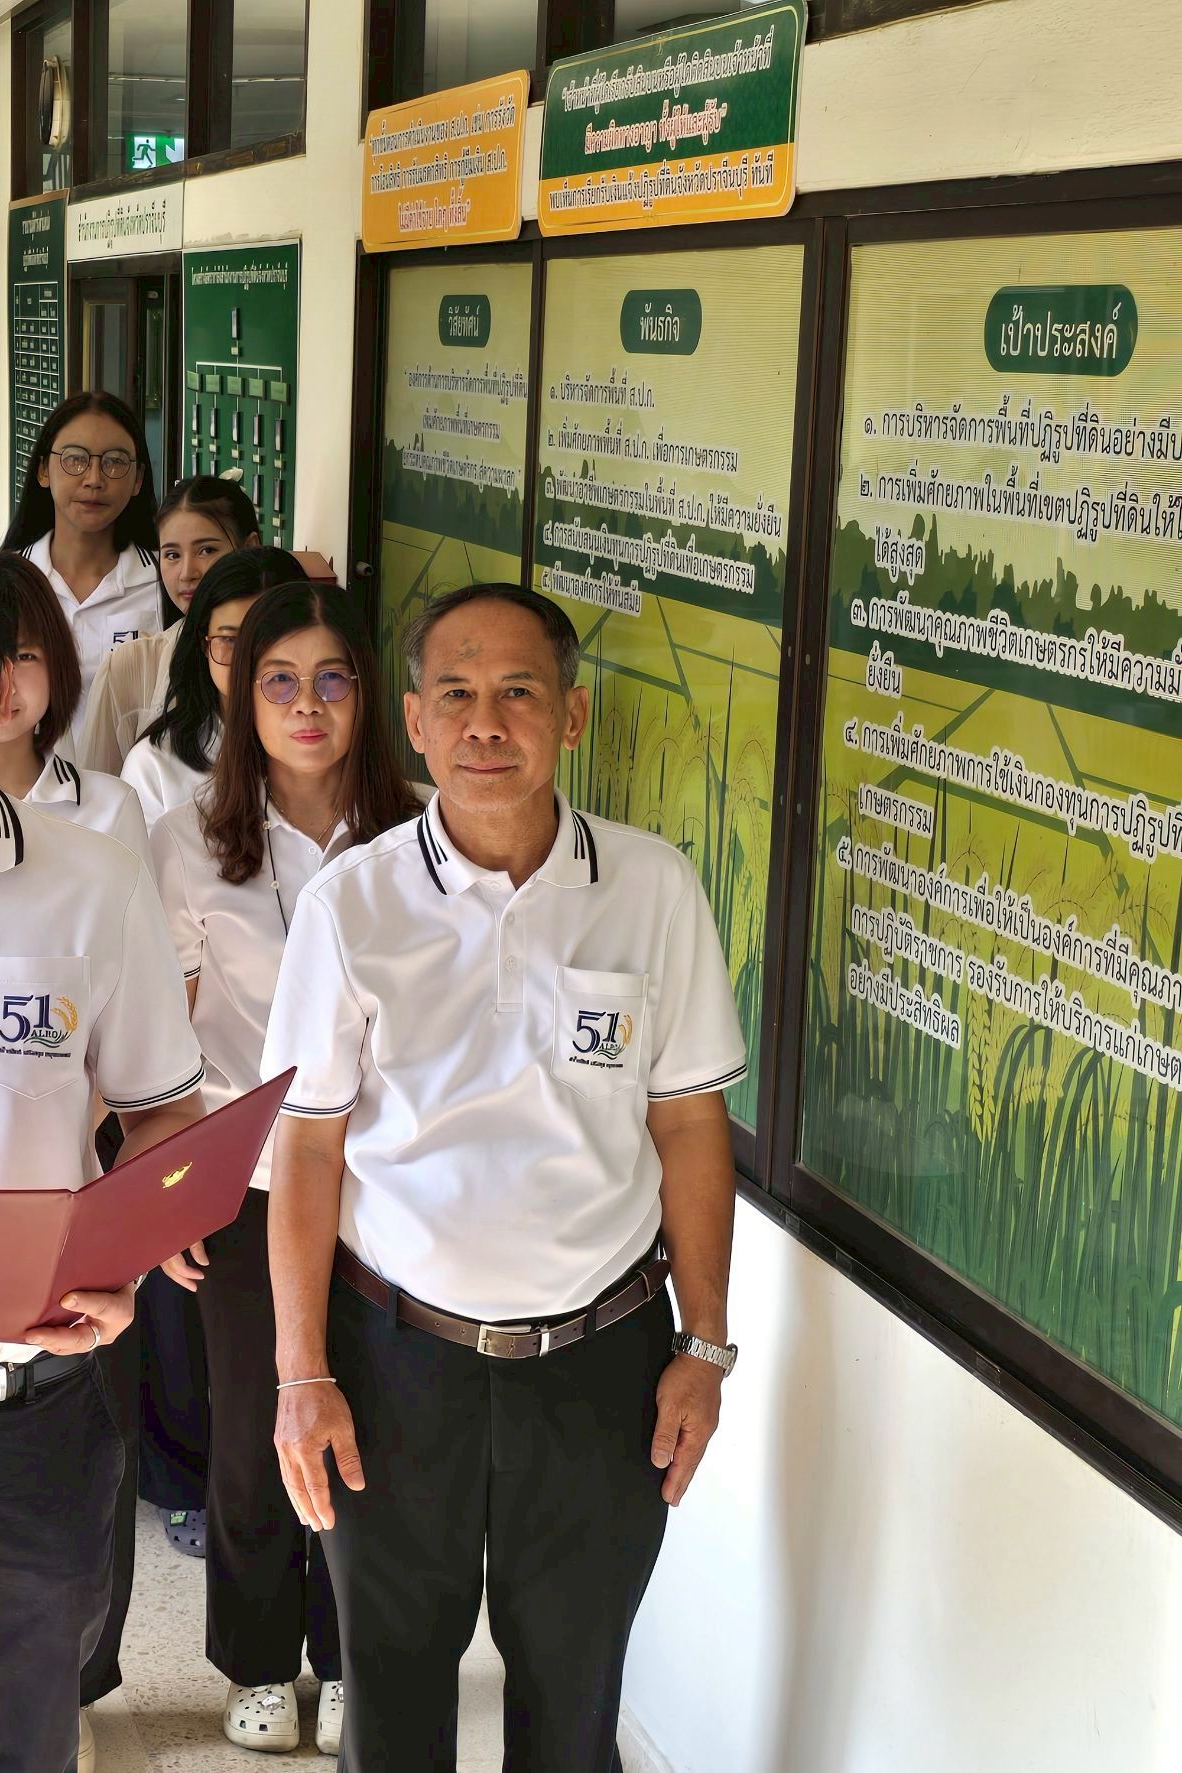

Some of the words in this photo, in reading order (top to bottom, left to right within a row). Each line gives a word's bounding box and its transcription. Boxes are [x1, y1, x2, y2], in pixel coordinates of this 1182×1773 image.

[449, 306, 480, 337] วิสัยทัศน์
[640, 303, 680, 342] พันธกิจ
[999, 302, 1122, 359] เป้าประสงค์
[561, 368, 628, 405] บริหารจัดการพื้นที่
[864, 416, 877, 435] ๑.
[860, 473, 873, 498] ๒.
[875, 525, 924, 581] ได้สูงสุด
[852, 602, 867, 625] ๓.
[867, 643, 902, 695] ยั่งยืน
[845, 720, 859, 747] ๔.
[859, 786, 932, 834] เกษตรกรรม
[837, 840, 852, 866] ๕.
[853, 906, 963, 980] การปฏิบัติราชการ
[0, 994, 54, 1042] 51
[850, 966, 960, 1045] อย่างมีประสิทธิผล
[31, 1029, 59, 1039] ALRO
[572, 1010, 619, 1053] 51
